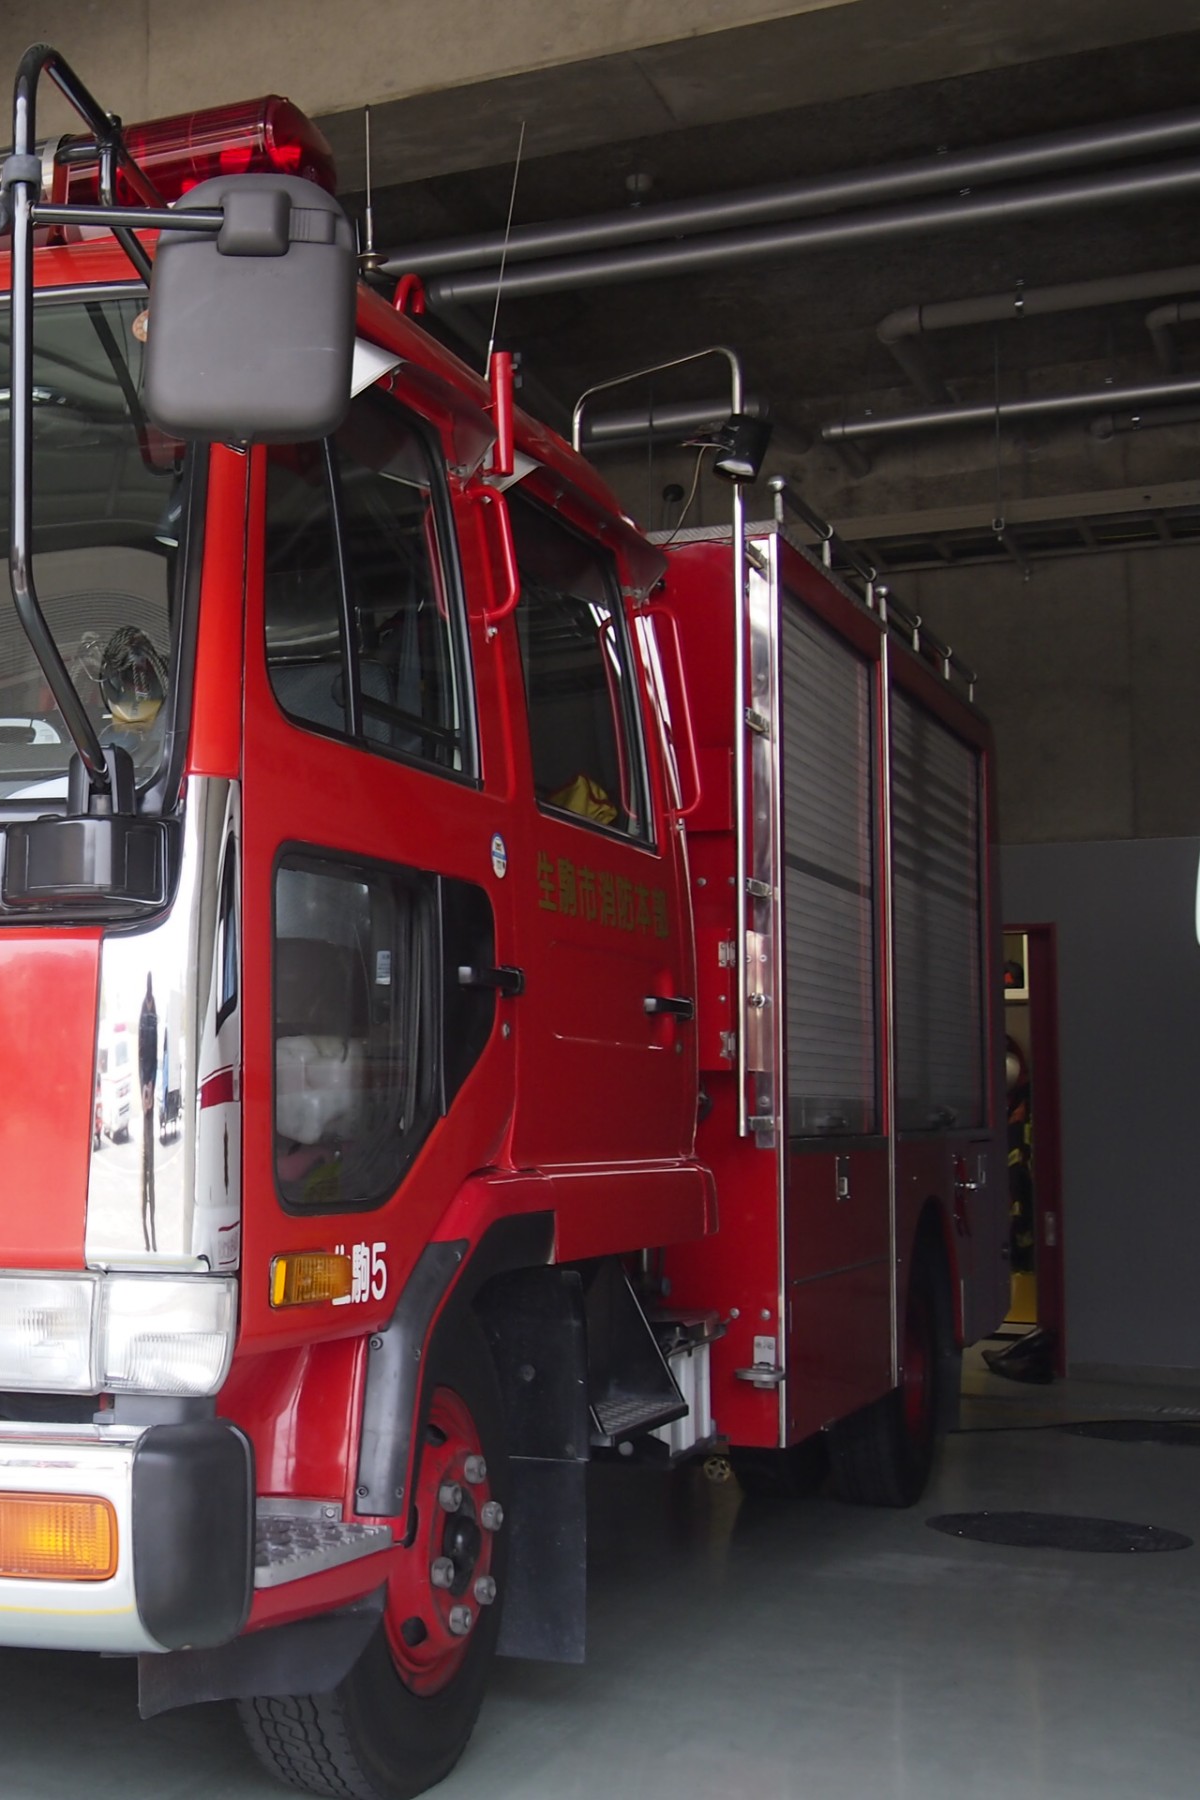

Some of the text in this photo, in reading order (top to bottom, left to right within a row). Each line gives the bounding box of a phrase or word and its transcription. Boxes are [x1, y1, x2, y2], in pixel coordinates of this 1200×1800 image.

[537, 850, 670, 940] 生駒市消防本部
